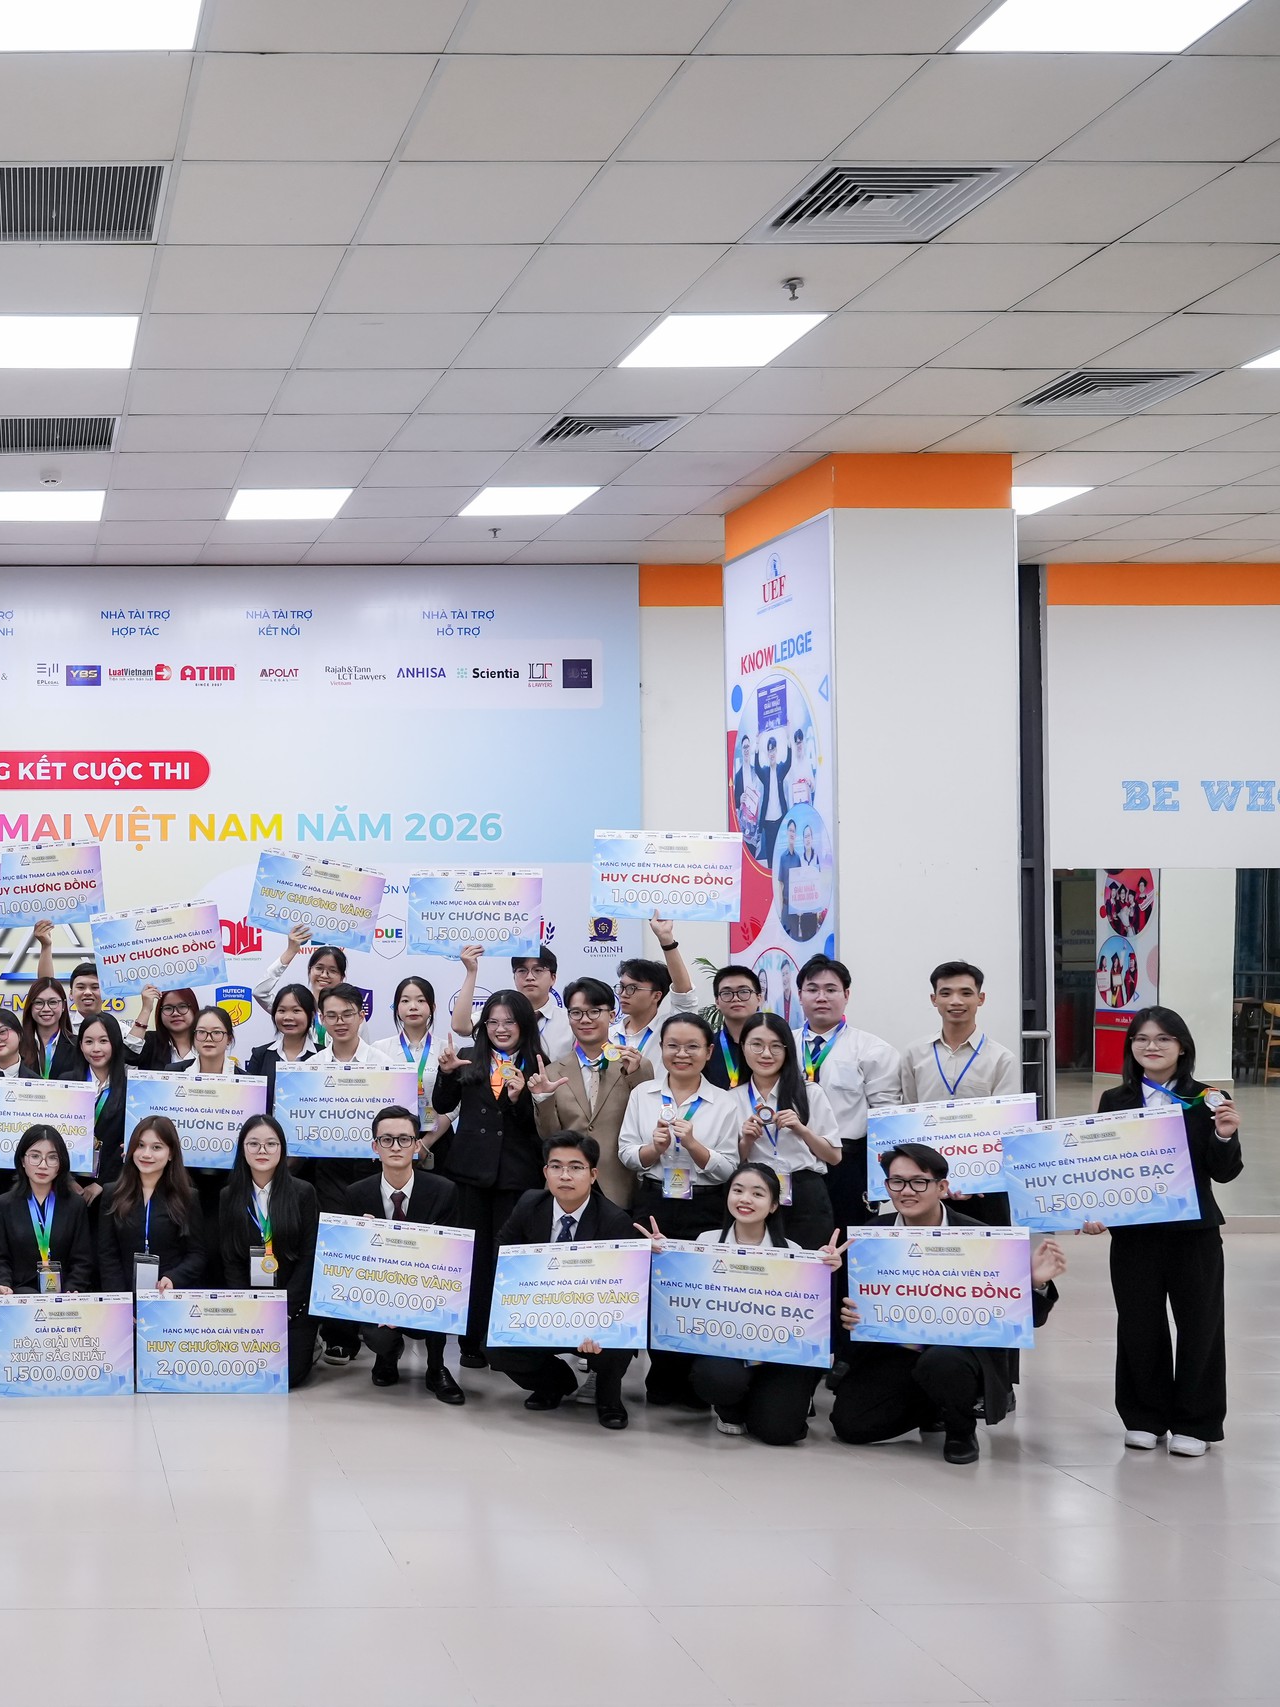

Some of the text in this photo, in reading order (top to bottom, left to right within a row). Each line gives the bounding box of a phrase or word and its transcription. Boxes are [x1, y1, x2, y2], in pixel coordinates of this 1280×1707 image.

[762, 575, 786, 603] UEF
[100, 609, 170, 622] NHÀ TÀI TRỢ
[246, 609, 313, 622] NHÀ TÀI TRỢ
[422, 609, 495, 622] NHÀ TÀI TRỢ
[111, 626, 160, 638] HỢP TÁC
[258, 624, 300, 636] KẾT NỐI
[436, 623, 481, 638] HỖ TRỢ
[740, 630, 812, 676] KNOWLEDGE
[70, 670, 98, 678] YBS
[108, 668, 153, 676] LuatVietnam
[180, 665, 235, 681] ATIM
[259, 668, 299, 678] APOLAT
[354, 673, 387, 682] Lawyers
[396, 667, 446, 678] ANHISA
[472, 667, 520, 679] Scientia
[18, 754, 66, 780] KẾT
[73, 757, 142, 786] CUỘC
[150, 762, 190, 780] THI
[1122, 780, 1280, 812] BE WH
[84, 805, 176, 852] VIỆT
[189, 813, 283, 842] NAM
[297, 805, 392, 842] NĂM
[404, 812, 502, 842] 2026
[600, 871, 734, 887] HUY CHƯƠNG ĐỒNG
[421, 910, 529, 924] HUY CHƯƠNG BẠC
[374, 928, 403, 939] DUE
[583, 946, 623, 954] GIA DINH
[1103, 1154, 1118, 1163] GIA
[1024, 1162, 1174, 1190] HUY CHƯƠNG BẠC
[858, 1282, 1022, 1300] HUY CHƯƠNG ĐỒNG
[35, 1326, 82, 1335] GIẢI ĐẶC BIỆT
[13, 1334, 100, 1349] HÒA GIẢI VIÊN
[10, 1348, 106, 1362] XUẤT SẮC NHẤT
